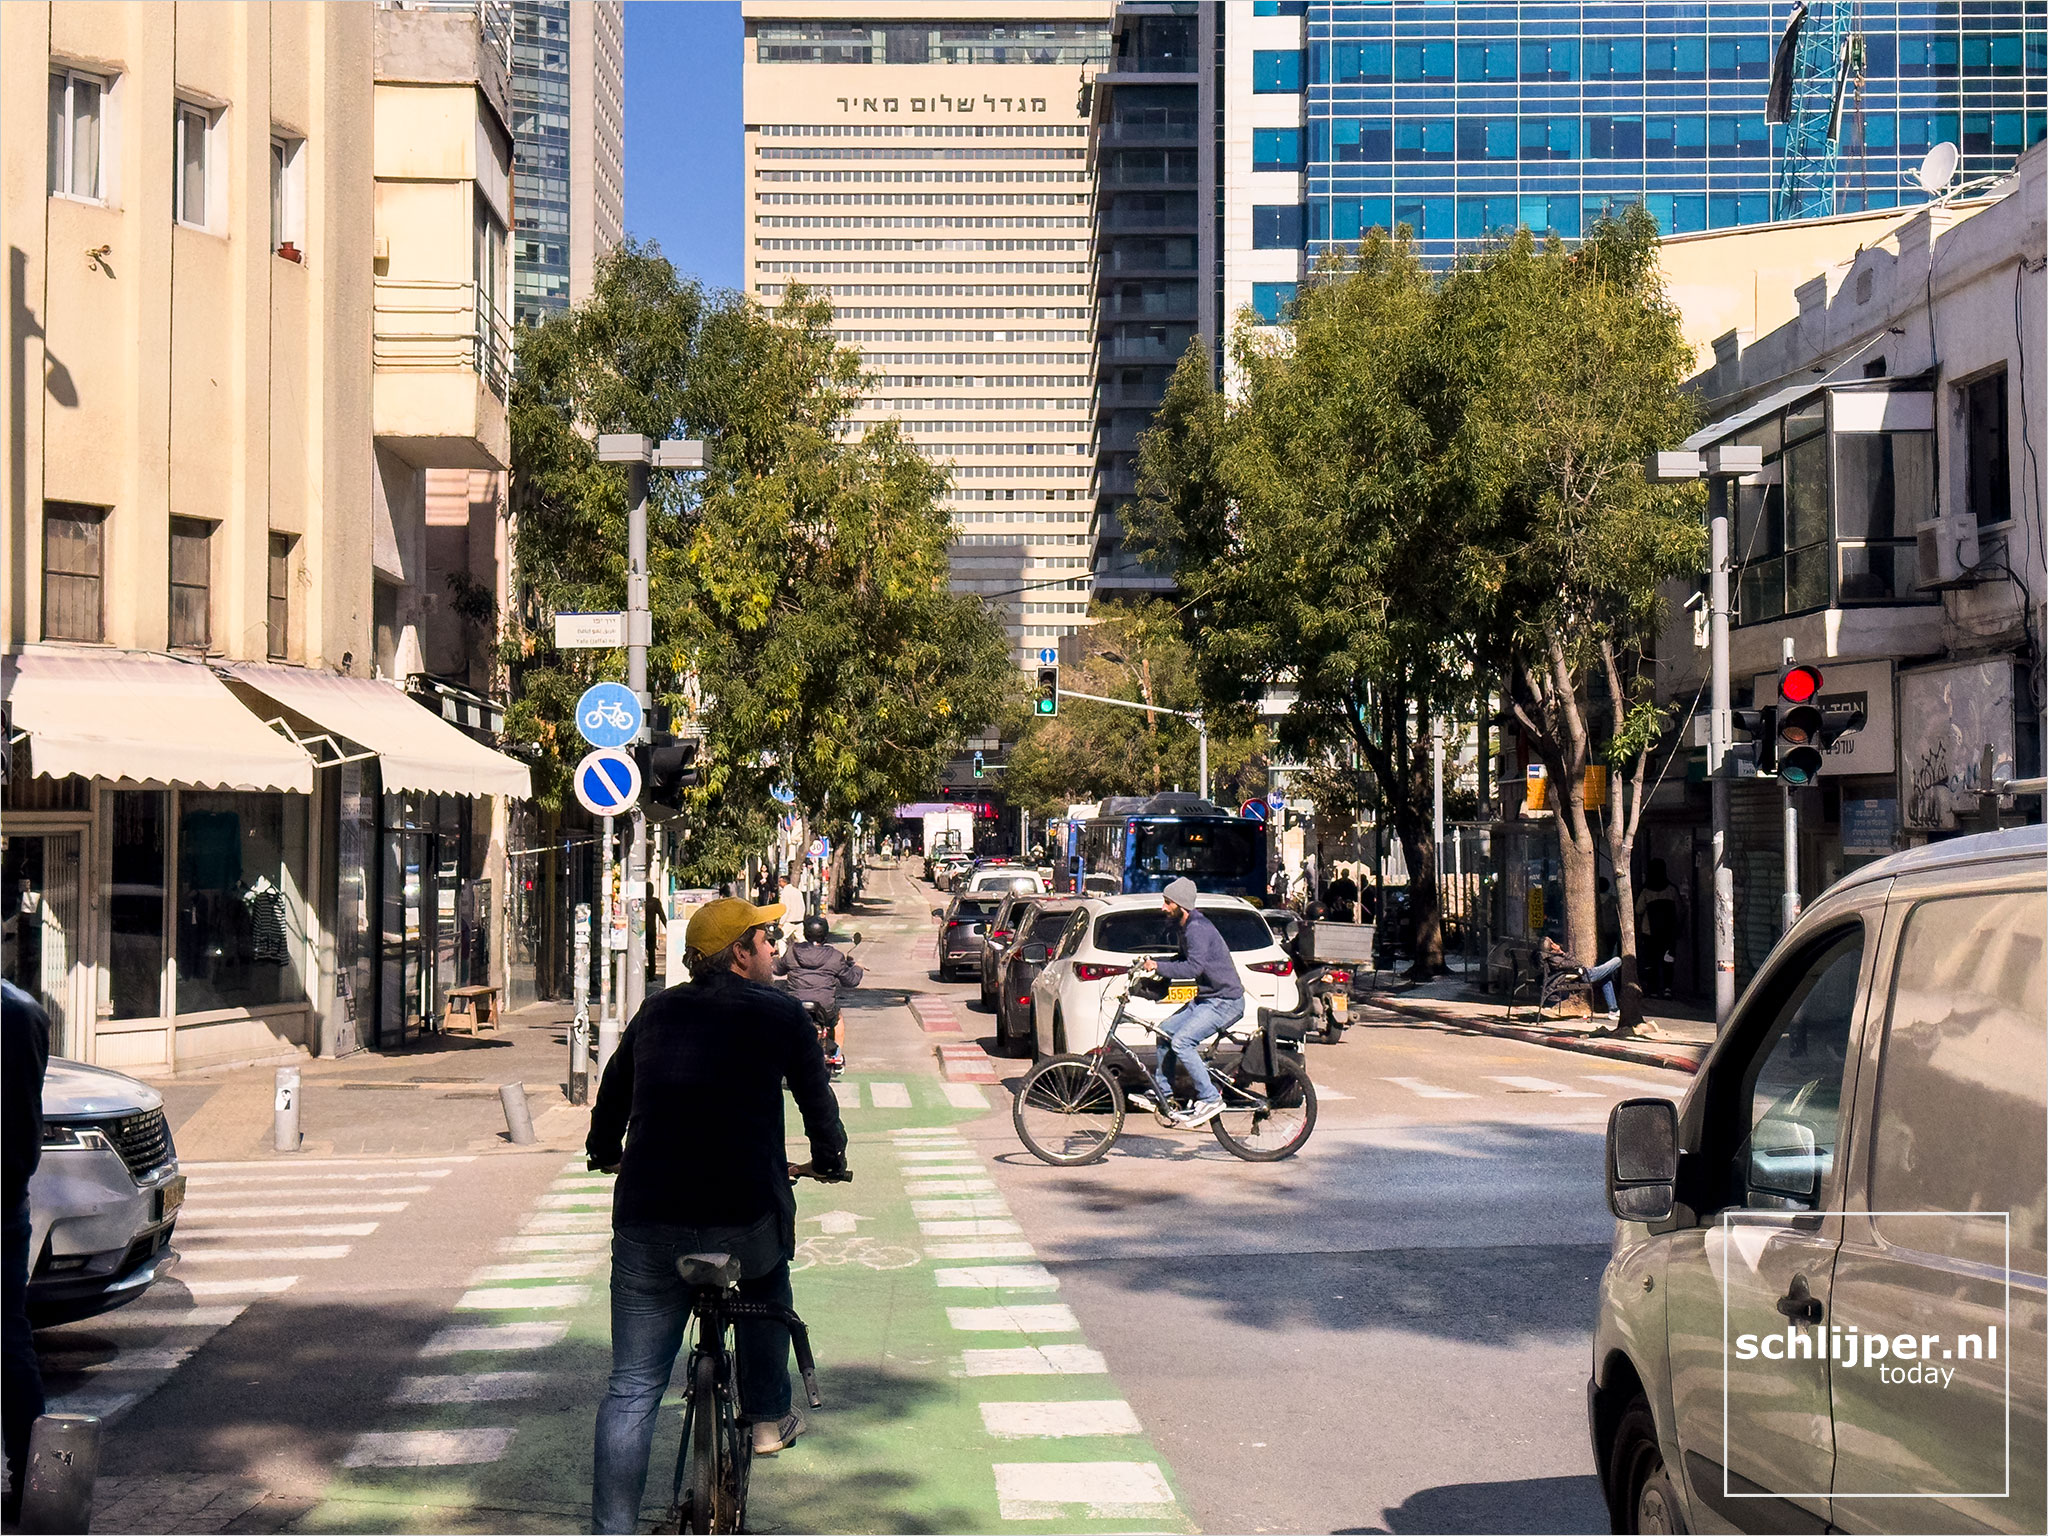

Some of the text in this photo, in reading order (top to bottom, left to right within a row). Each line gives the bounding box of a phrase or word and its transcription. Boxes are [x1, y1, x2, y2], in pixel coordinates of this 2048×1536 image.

[837, 94, 1046, 112] מגדל שלום מאיר
